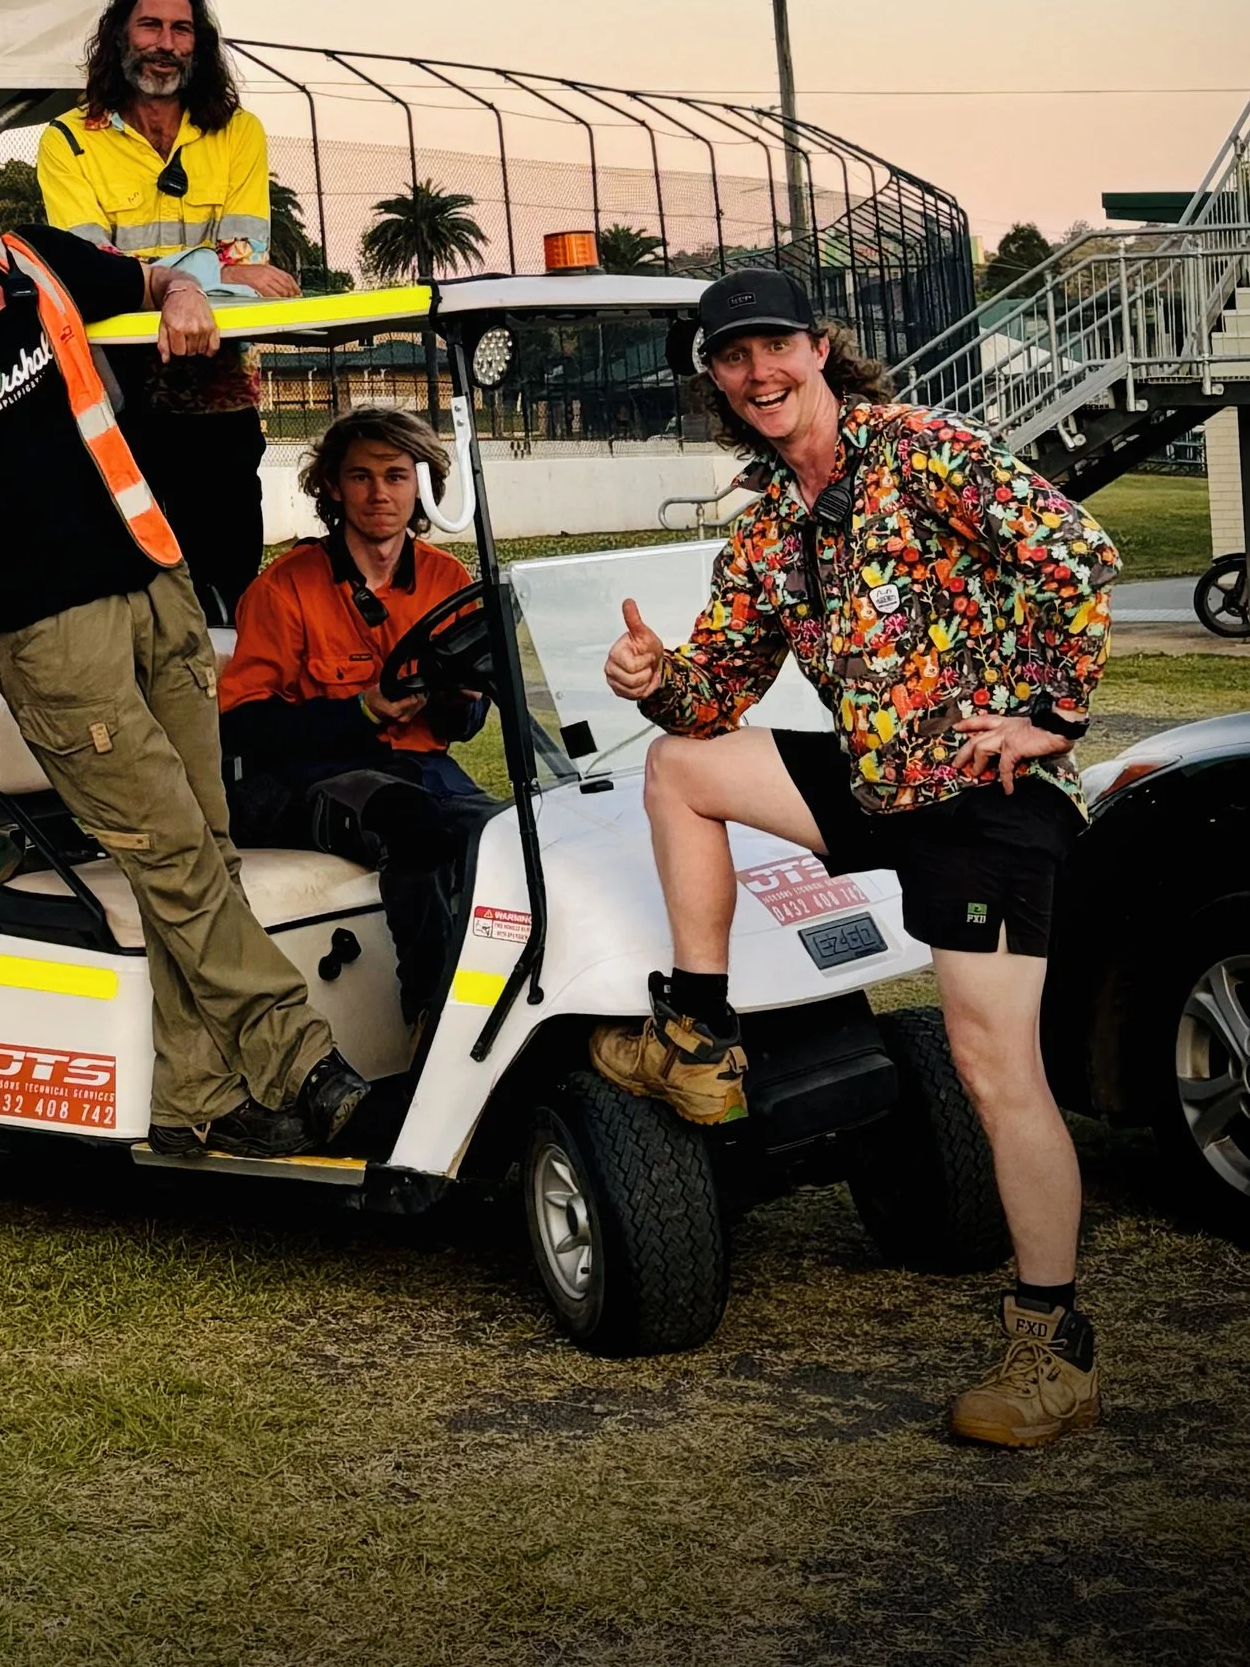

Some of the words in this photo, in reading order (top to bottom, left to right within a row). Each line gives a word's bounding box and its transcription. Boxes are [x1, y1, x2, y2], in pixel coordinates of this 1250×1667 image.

[772, 903, 810, 922] 0432
[813, 891, 839, 909] 408
[25, 1083, 69, 1097] TECHNICAL
[73, 1089, 115, 1103] SERVICES
[35, 1098, 69, 1119] 408
[81, 1103, 114, 1124] 742
[1015, 1317, 1048, 1337] FXD
